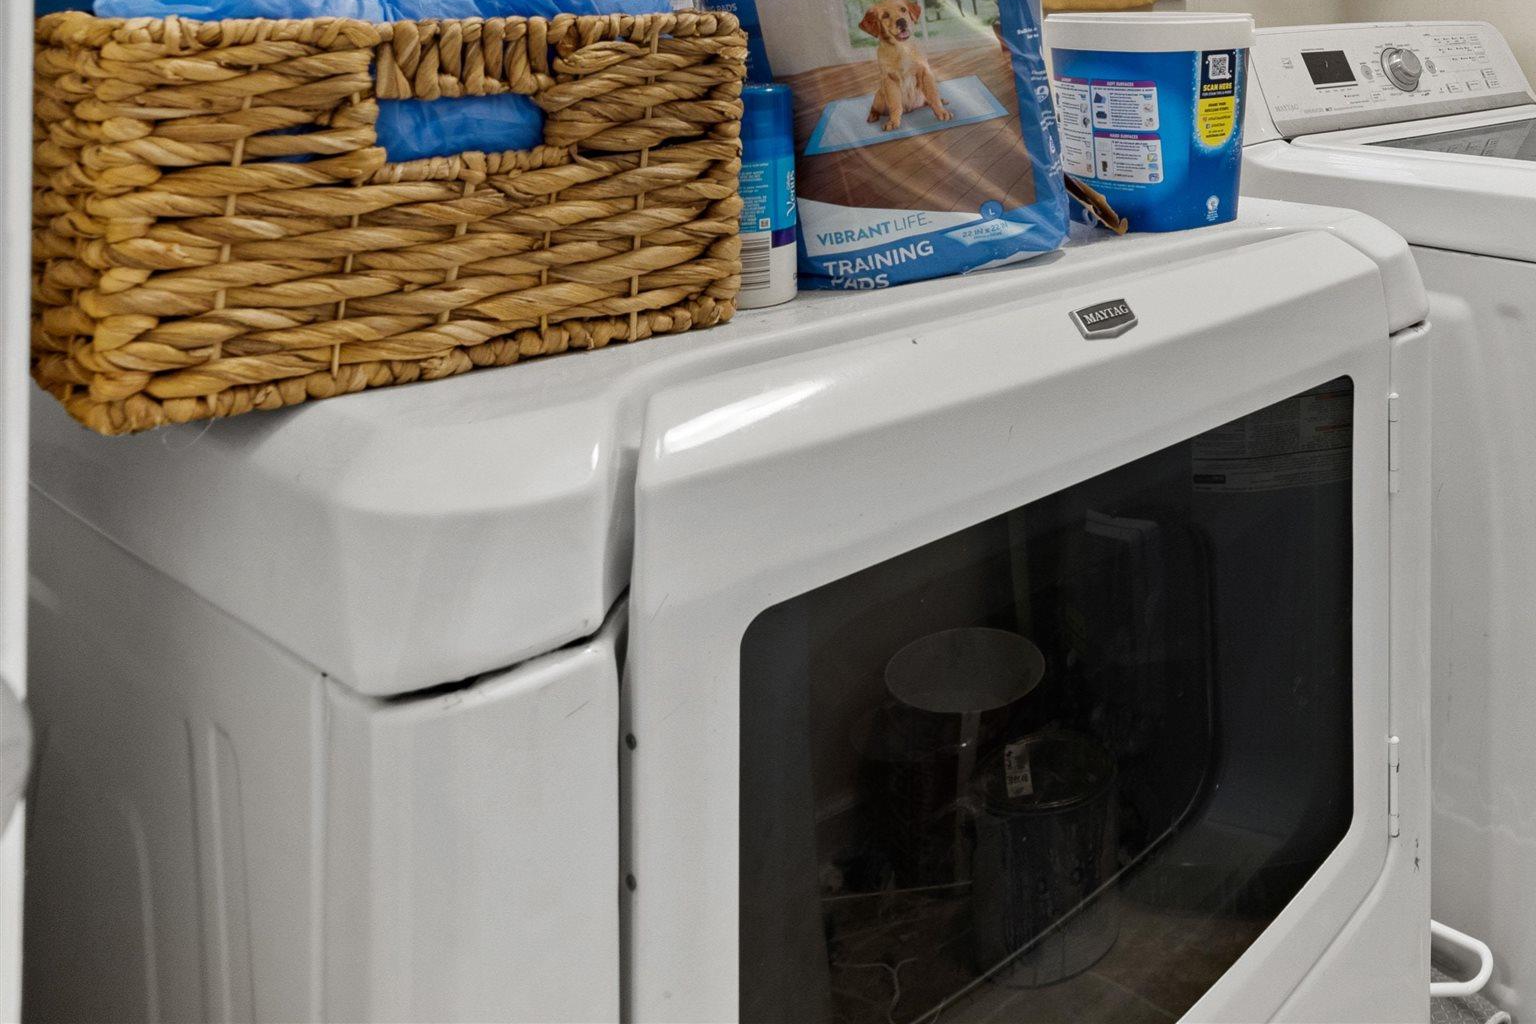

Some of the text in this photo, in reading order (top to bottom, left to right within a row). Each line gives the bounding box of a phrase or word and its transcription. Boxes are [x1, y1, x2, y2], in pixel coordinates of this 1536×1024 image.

[817, 222, 891, 246] VIBRANT
[823, 240, 934, 276] TRAINING
[1083, 304, 1129, 324] MAYTAG
